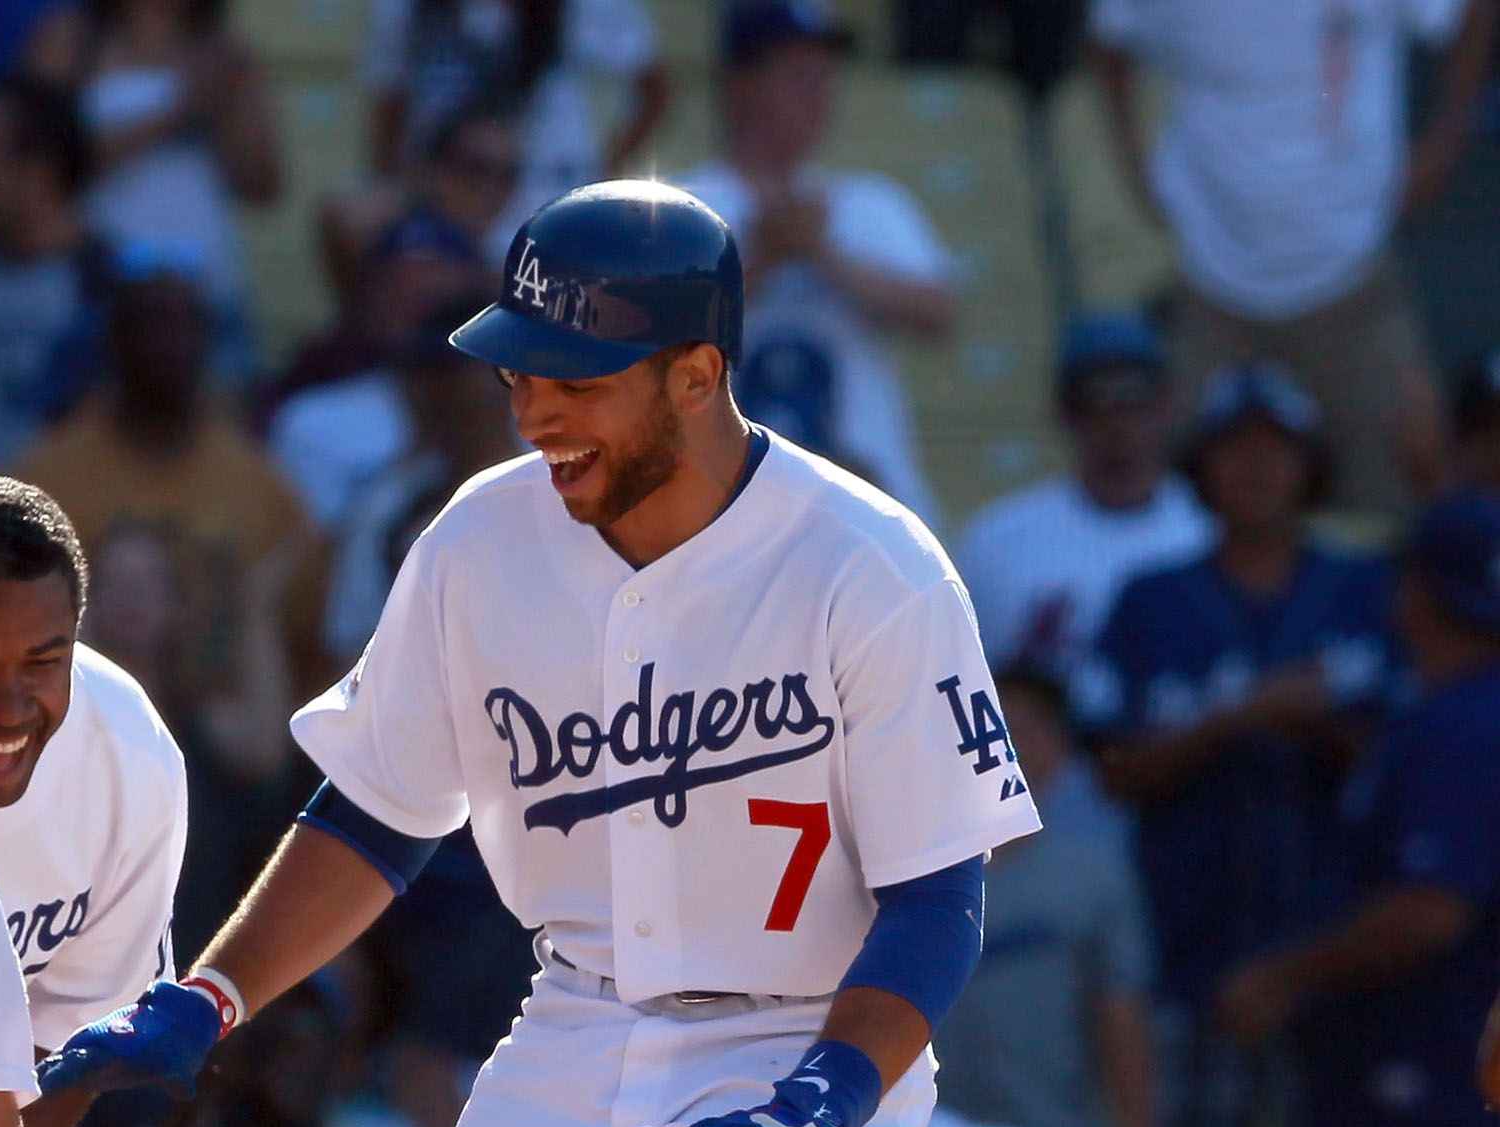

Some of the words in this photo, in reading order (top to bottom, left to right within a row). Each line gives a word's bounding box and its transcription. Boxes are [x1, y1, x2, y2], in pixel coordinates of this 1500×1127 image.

[513, 237, 548, 308] LA
[484, 661, 835, 838] Dodgers
[935, 674, 1018, 776] LA
[747, 797, 832, 932] 7
